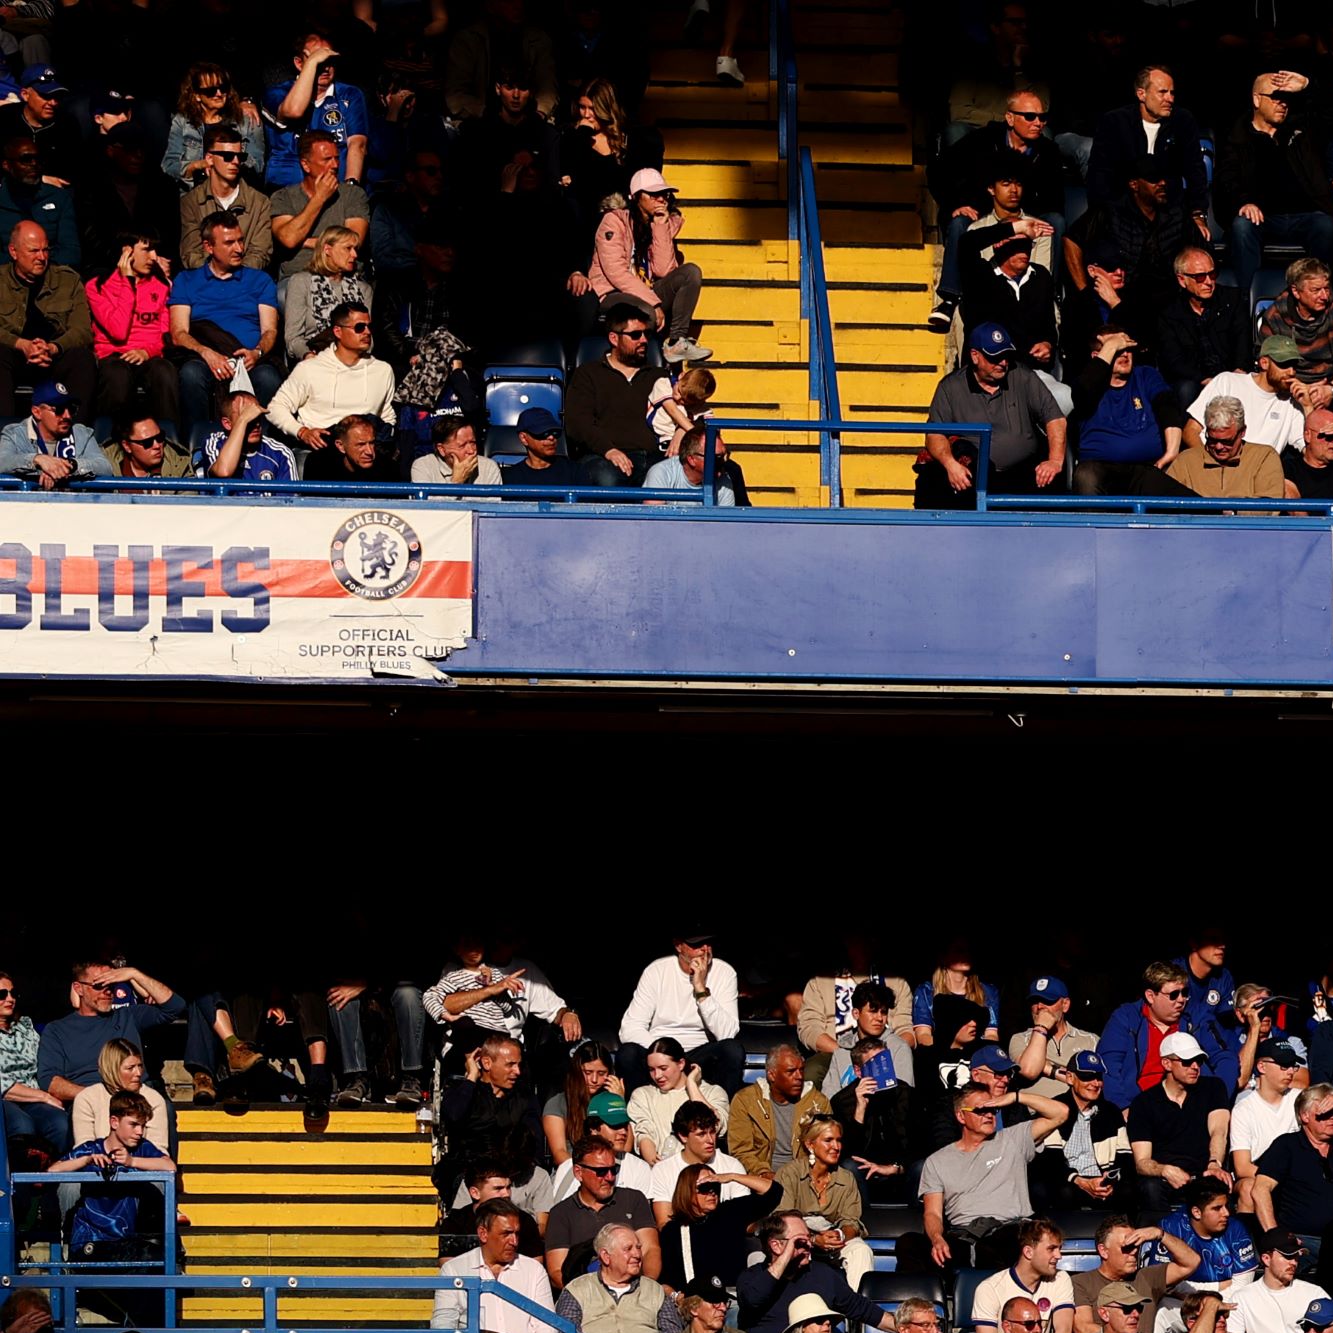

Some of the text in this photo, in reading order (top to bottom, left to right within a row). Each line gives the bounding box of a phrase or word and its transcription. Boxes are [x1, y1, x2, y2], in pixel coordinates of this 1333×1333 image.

[345, 513, 406, 533] CHELSEA
[345, 580, 408, 598] FOOTBALL CLUB
[338, 628, 414, 641] OFFICIAL
[298, 644, 407, 658] SUPPORTERS
[342, 660, 412, 670] PHILLY BLUES
